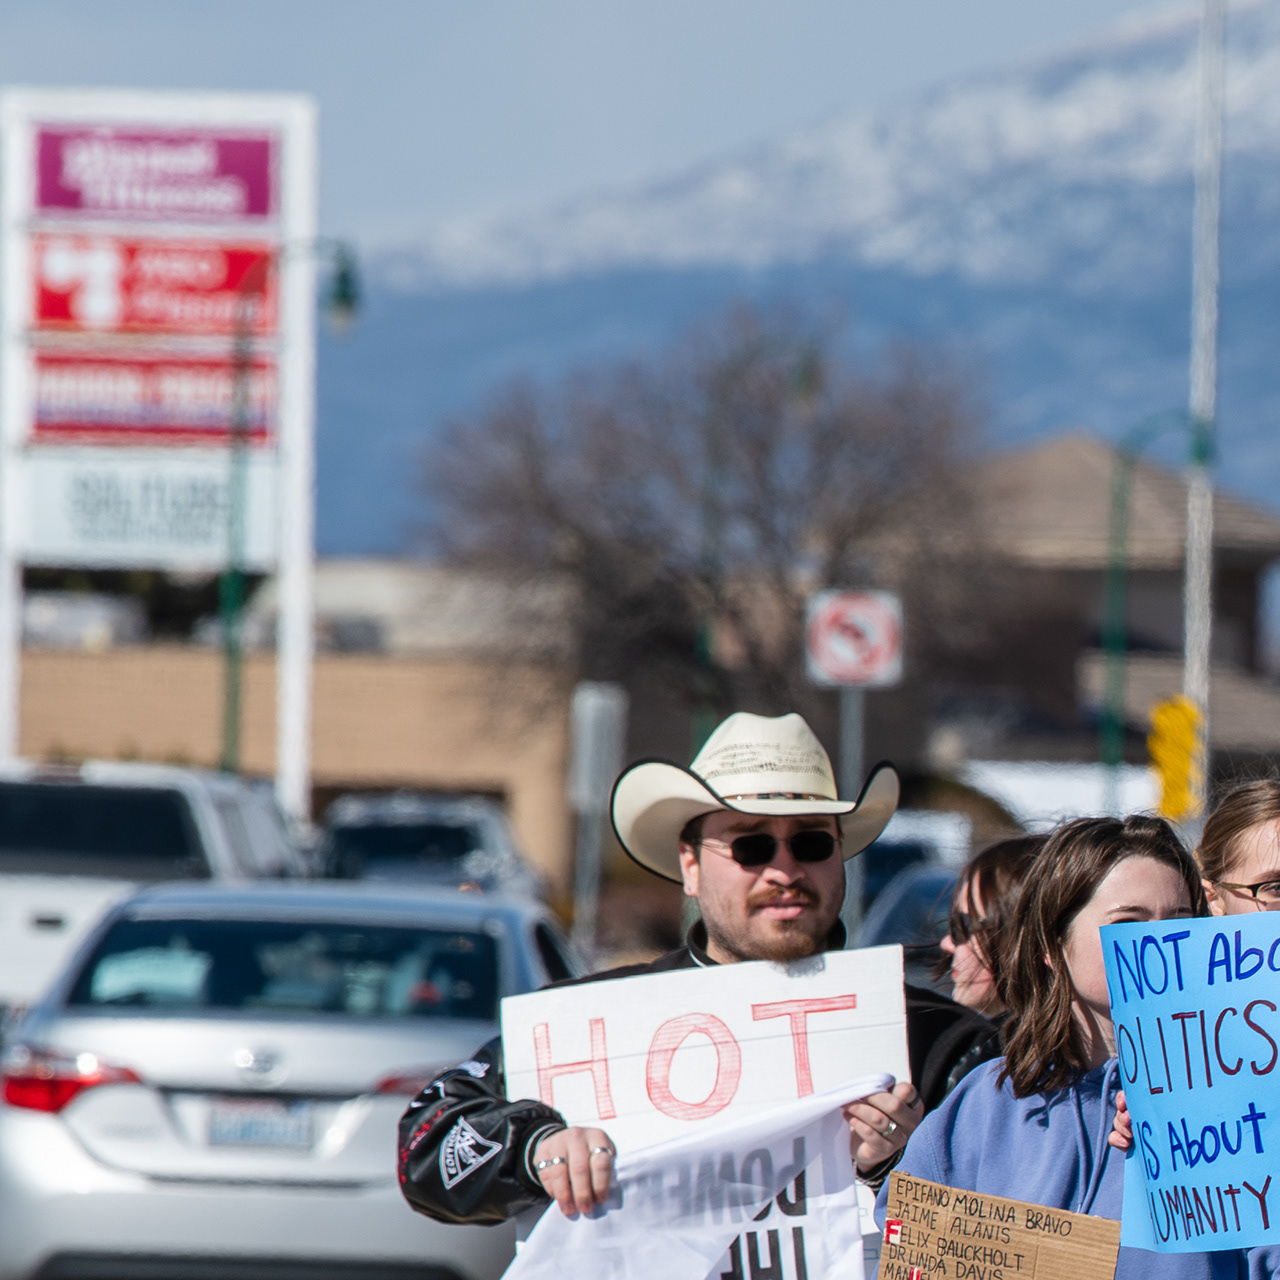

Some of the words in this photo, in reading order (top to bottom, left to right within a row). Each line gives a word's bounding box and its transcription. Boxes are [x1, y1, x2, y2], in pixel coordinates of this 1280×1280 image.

[1113, 930, 1190, 1004] NOT
[532, 994, 857, 1121] HOT
[1117, 999, 1278, 1095] OLITICS
[1136, 1120, 1160, 1181] IS
[1168, 1102, 1266, 1172] About
[895, 1200, 938, 1230] JAIME
[950, 1217, 1011, 1245] ALANIS
[897, 1178, 949, 1208] EPIFANO
[952, 1195, 1015, 1223] MOLINA
[1025, 1209, 1072, 1237] BRAVO
[884, 1219, 929, 1249] FELIX
[937, 1238, 1025, 1272] BAUCKHOLT
[908, 1248, 946, 1275] LINDA
